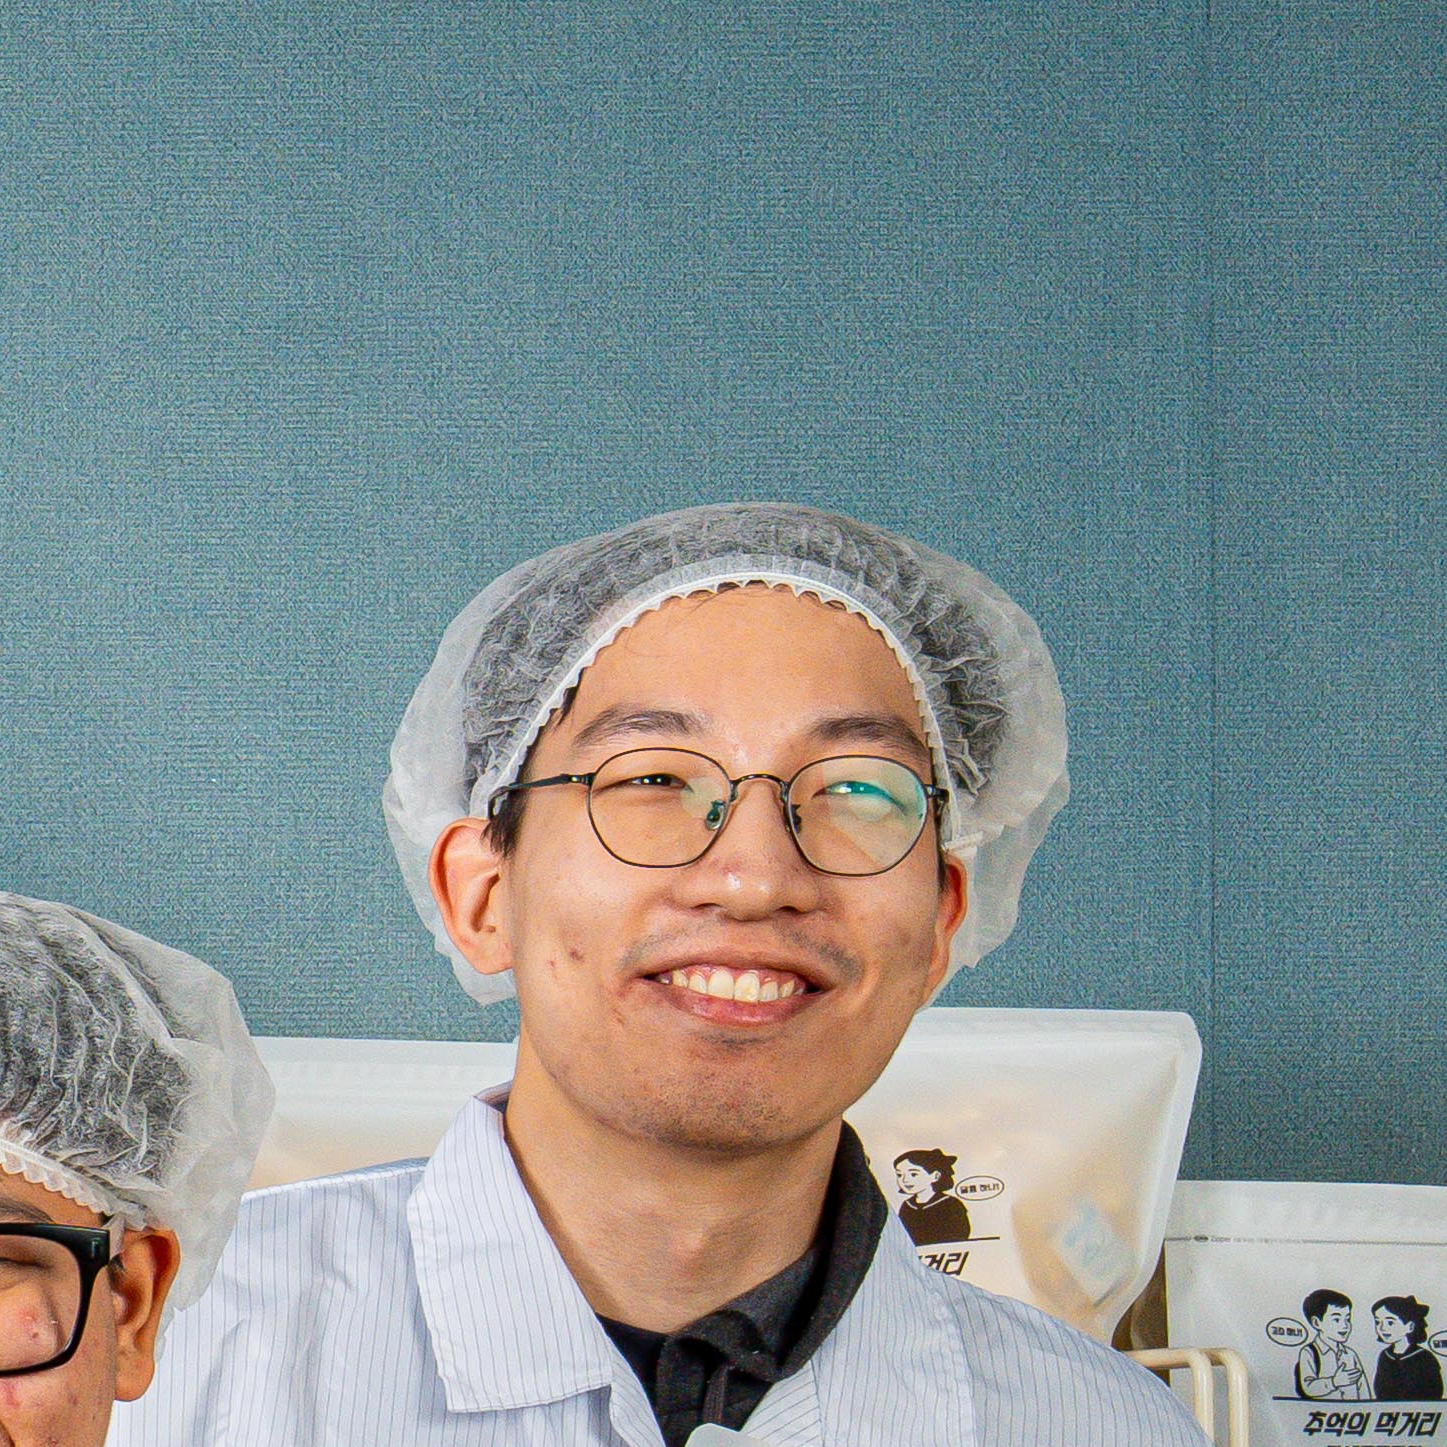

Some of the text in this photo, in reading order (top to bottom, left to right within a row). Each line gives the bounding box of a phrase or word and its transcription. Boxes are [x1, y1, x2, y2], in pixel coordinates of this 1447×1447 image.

[918, 1251, 970, 1275] 거리
[1303, 1411, 1443, 1437] 추억의 먹거리
